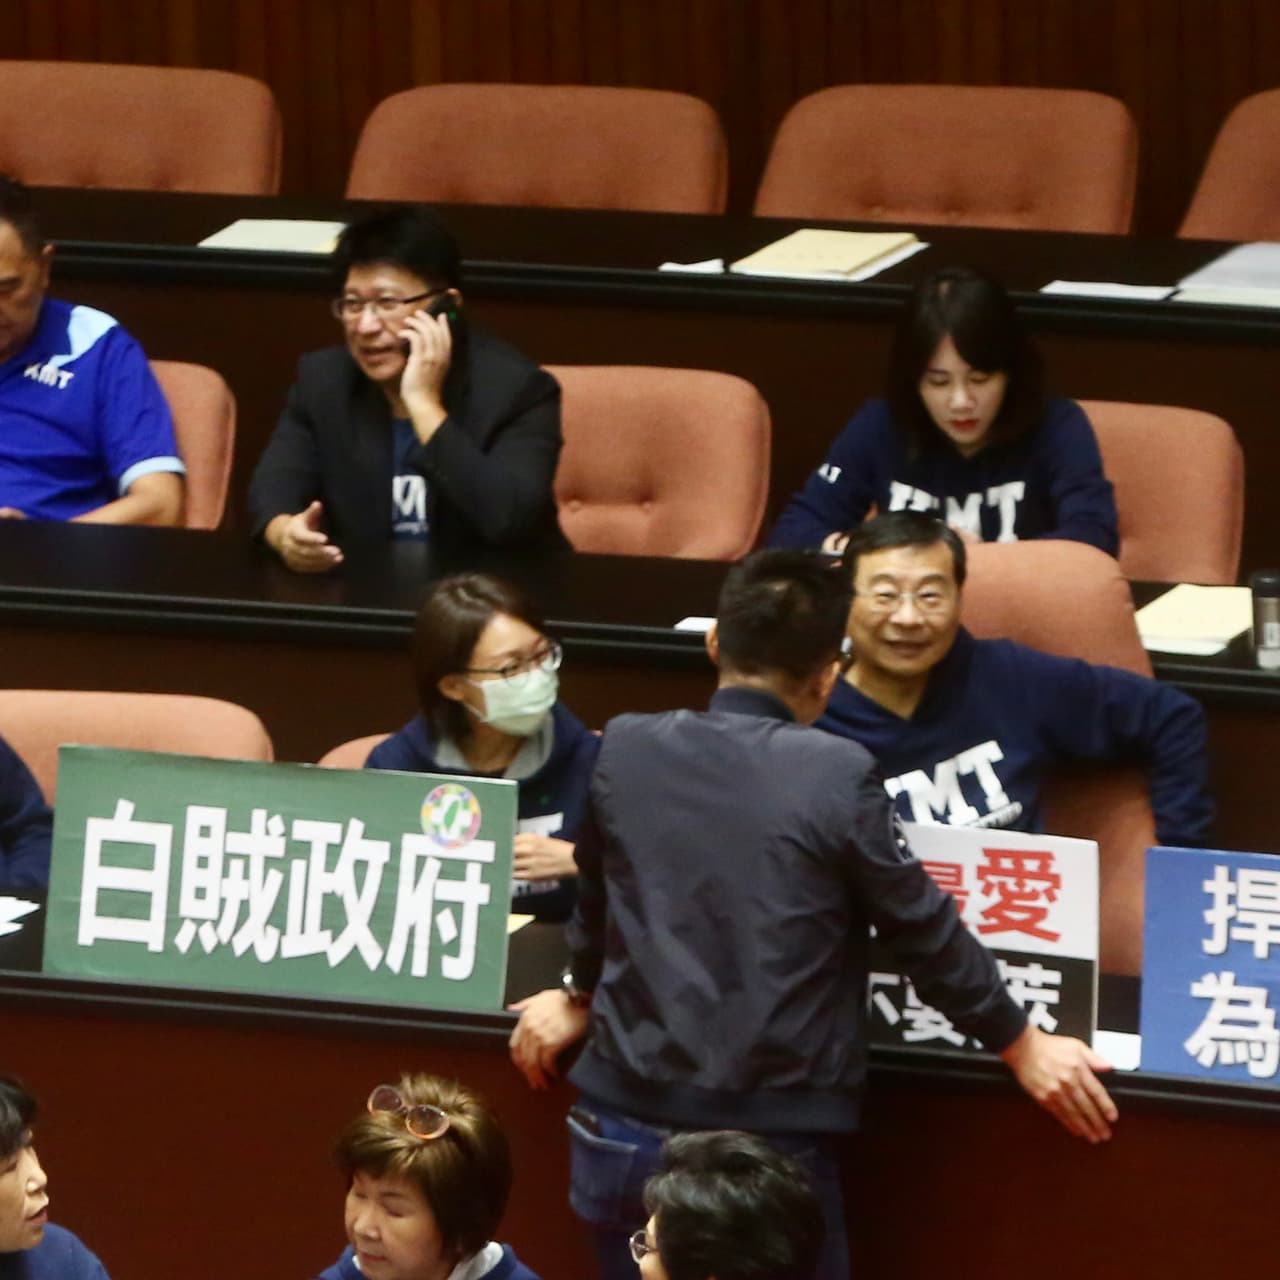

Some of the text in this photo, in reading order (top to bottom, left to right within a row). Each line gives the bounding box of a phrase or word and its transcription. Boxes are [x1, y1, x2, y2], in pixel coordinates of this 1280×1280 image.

[883, 740, 1010, 826] MT
[77, 797, 496, 980] 白賊政府
